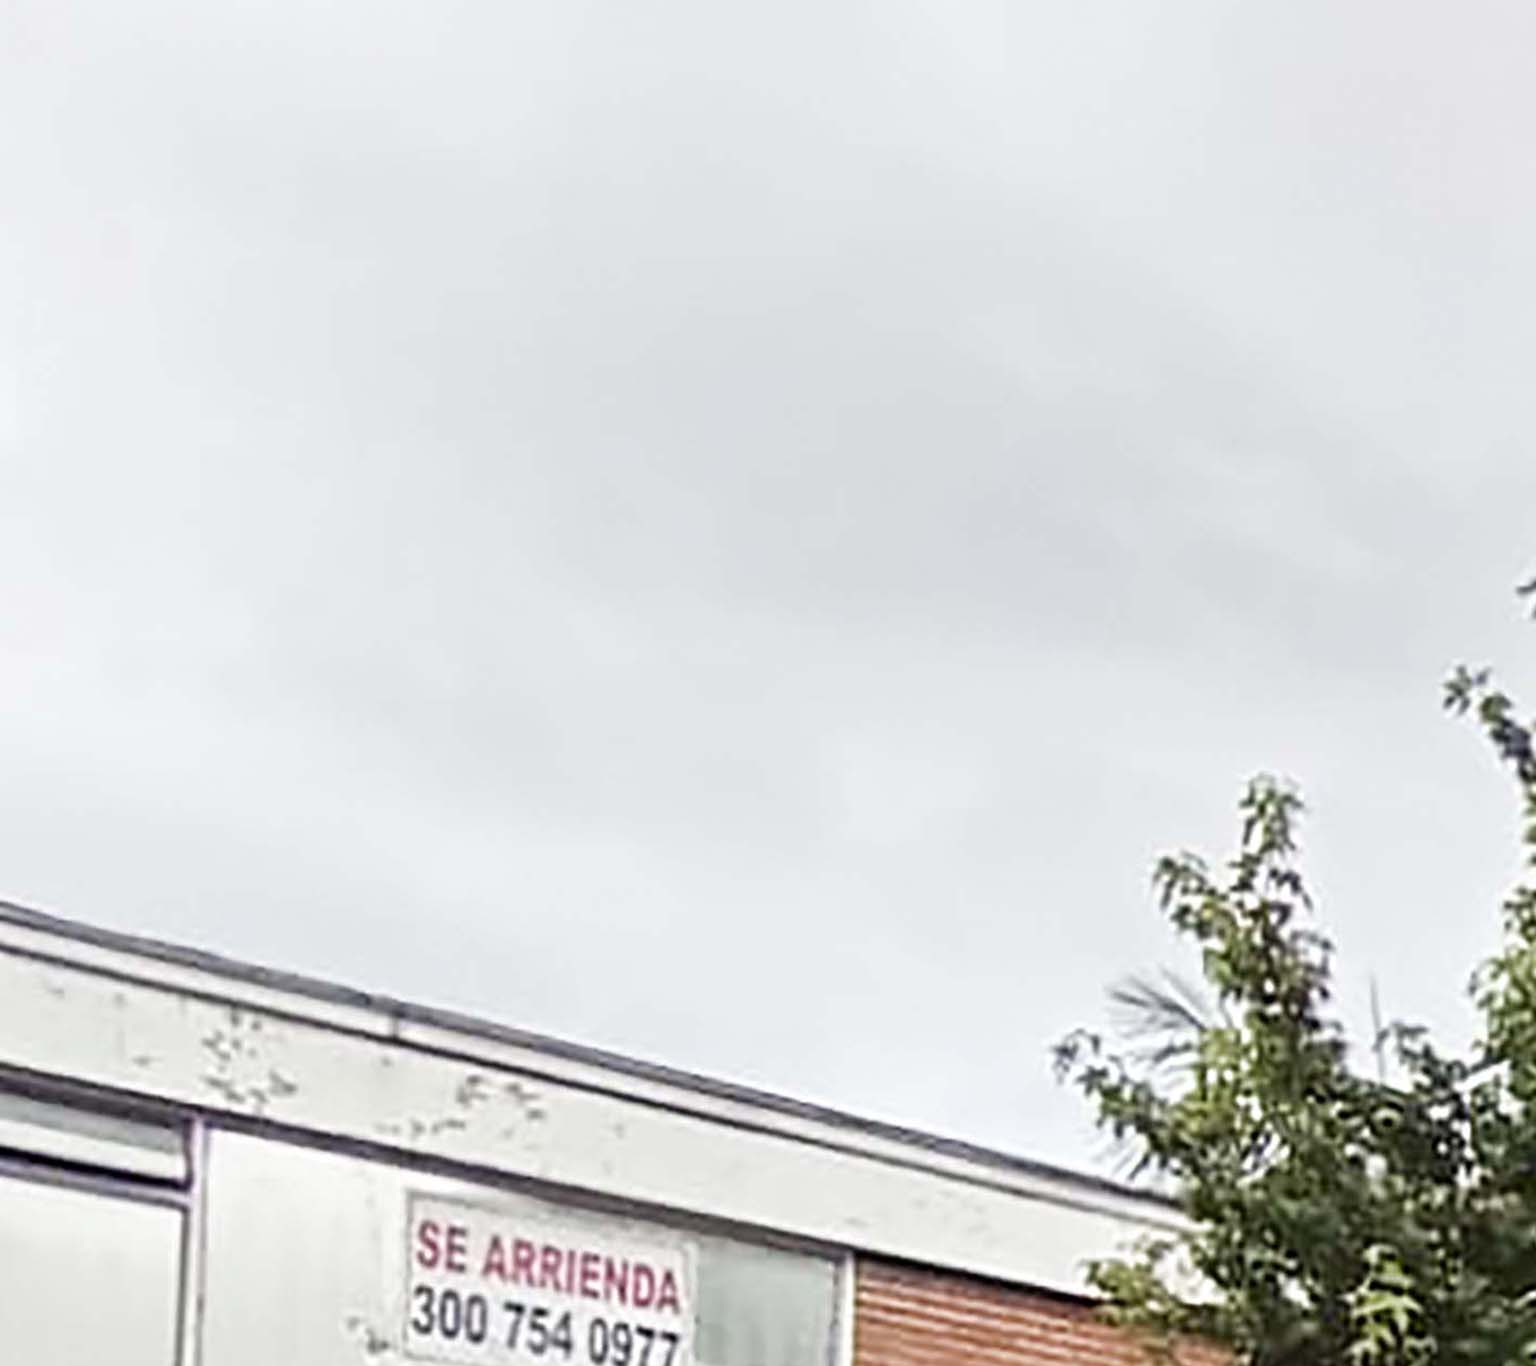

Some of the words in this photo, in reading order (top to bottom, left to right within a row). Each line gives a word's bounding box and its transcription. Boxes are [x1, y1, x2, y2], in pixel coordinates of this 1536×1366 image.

[416, 1219, 468, 1274] SE
[482, 1234, 681, 1316] ARRIENDA
[411, 1283, 488, 1345] 300
[503, 1301, 574, 1358] 754
